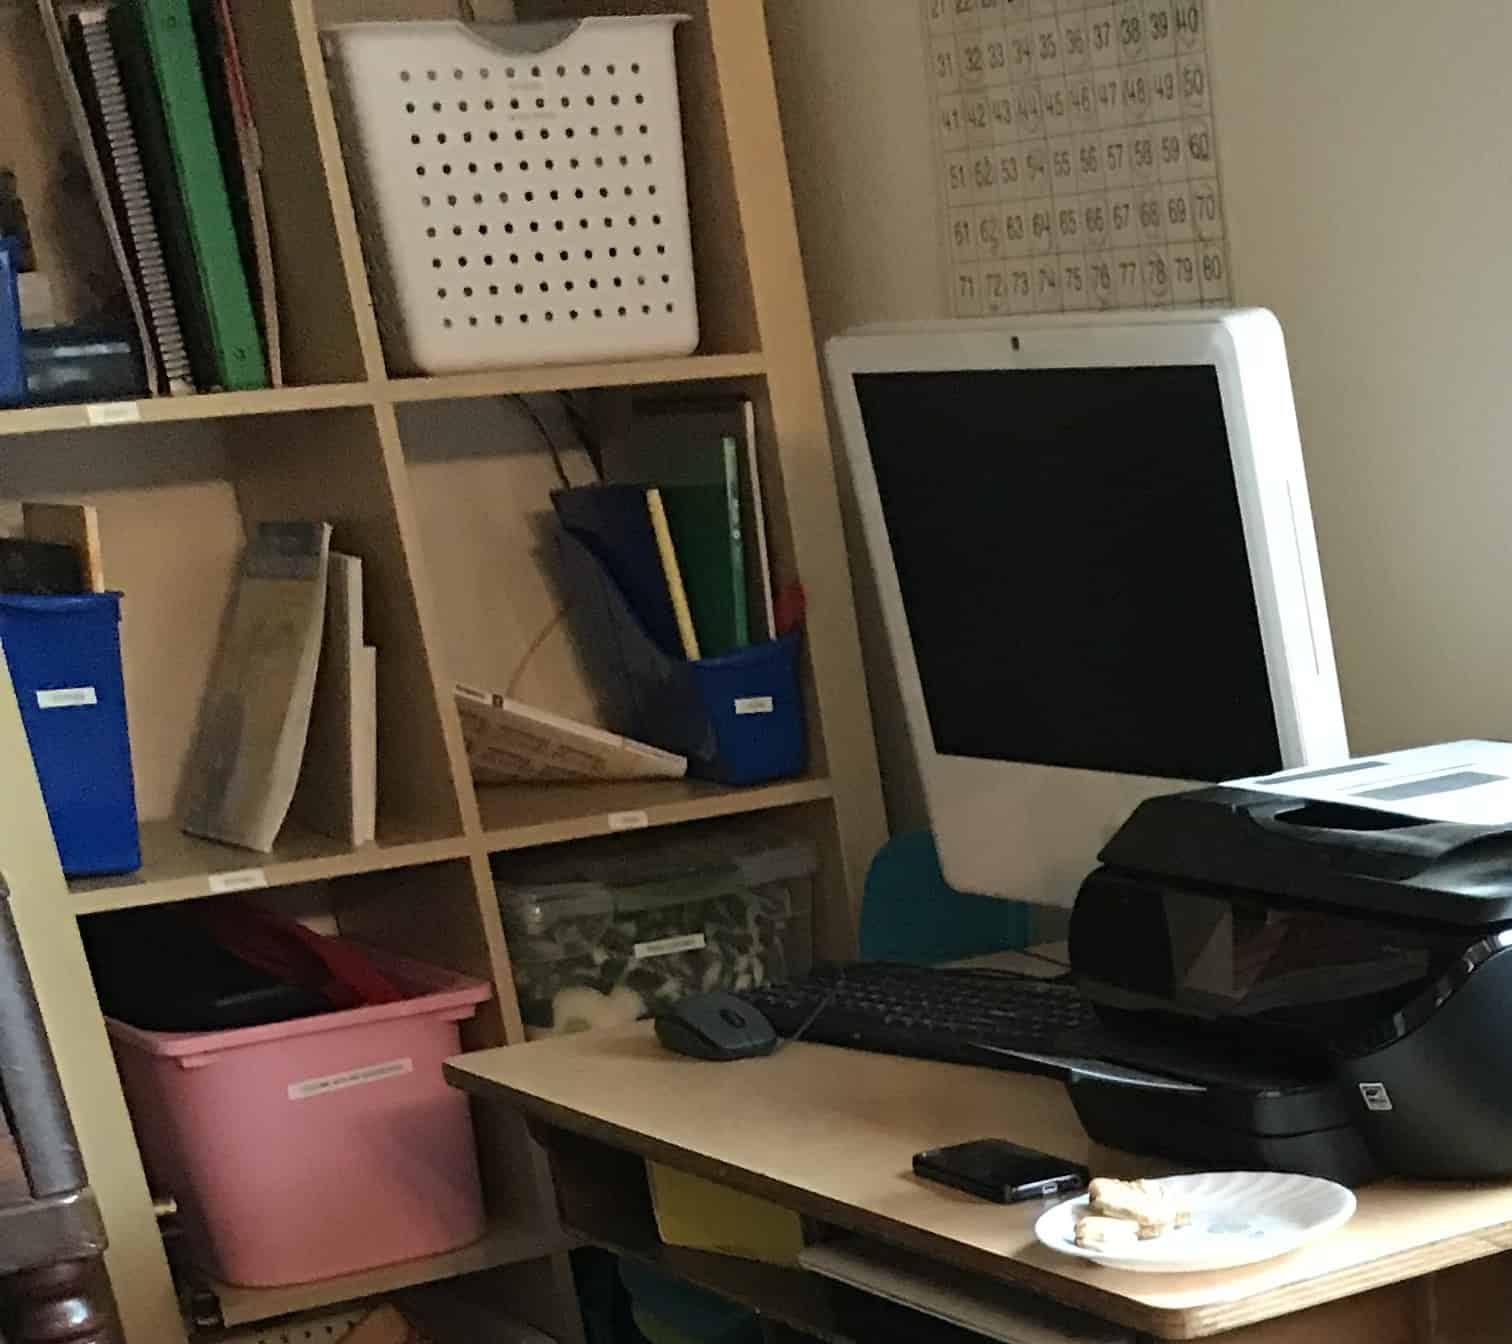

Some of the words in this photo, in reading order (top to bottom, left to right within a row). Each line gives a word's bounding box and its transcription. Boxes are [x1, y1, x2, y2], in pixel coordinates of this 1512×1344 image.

[1093, 21, 1110, 51] 37
[1120, 17, 1141, 45] 38
[1150, 11, 1168, 40] 39
[1176, 7, 1198, 33] 40
[942, 108, 959, 131] 41
[968, 103, 986, 128] 42
[1045, 90, 1064, 116] 45
[1099, 81, 1117, 105] 47
[1128, 77, 1145, 104] 48
[1154, 72, 1174, 100] 49
[1183, 67, 1204, 97] 50
[1107, 143, 1123, 171] 57
[1189, 132, 1209, 160] 60
[1032, 211, 1051, 239] 64
[1113, 203, 1129, 230] 67
[1196, 194, 1215, 220] 70
[959, 275, 974, 297] 71
[1012, 271, 1029, 296] 73
[1065, 266, 1082, 291] 75
[1119, 261, 1136, 286] 77
[1148, 258, 1167, 284] 78
[1175, 256, 1193, 282] 79
